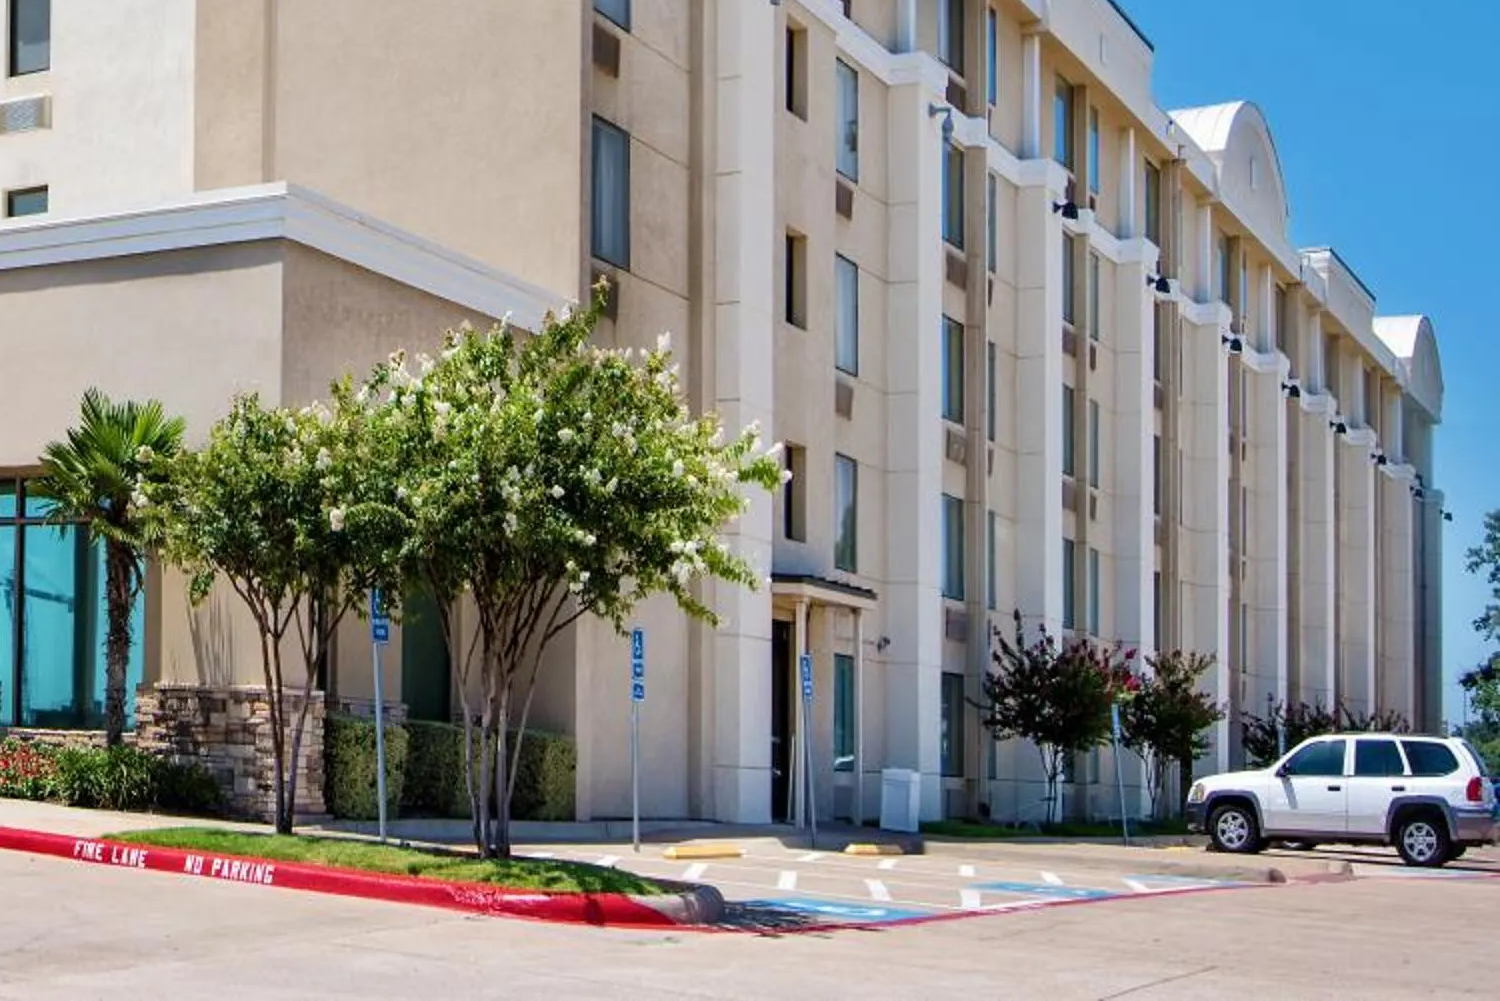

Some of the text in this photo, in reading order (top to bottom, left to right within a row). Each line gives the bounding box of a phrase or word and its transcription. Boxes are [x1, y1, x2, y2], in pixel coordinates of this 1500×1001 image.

[73, 840, 275, 884] FIRE LANE NO PARKING
